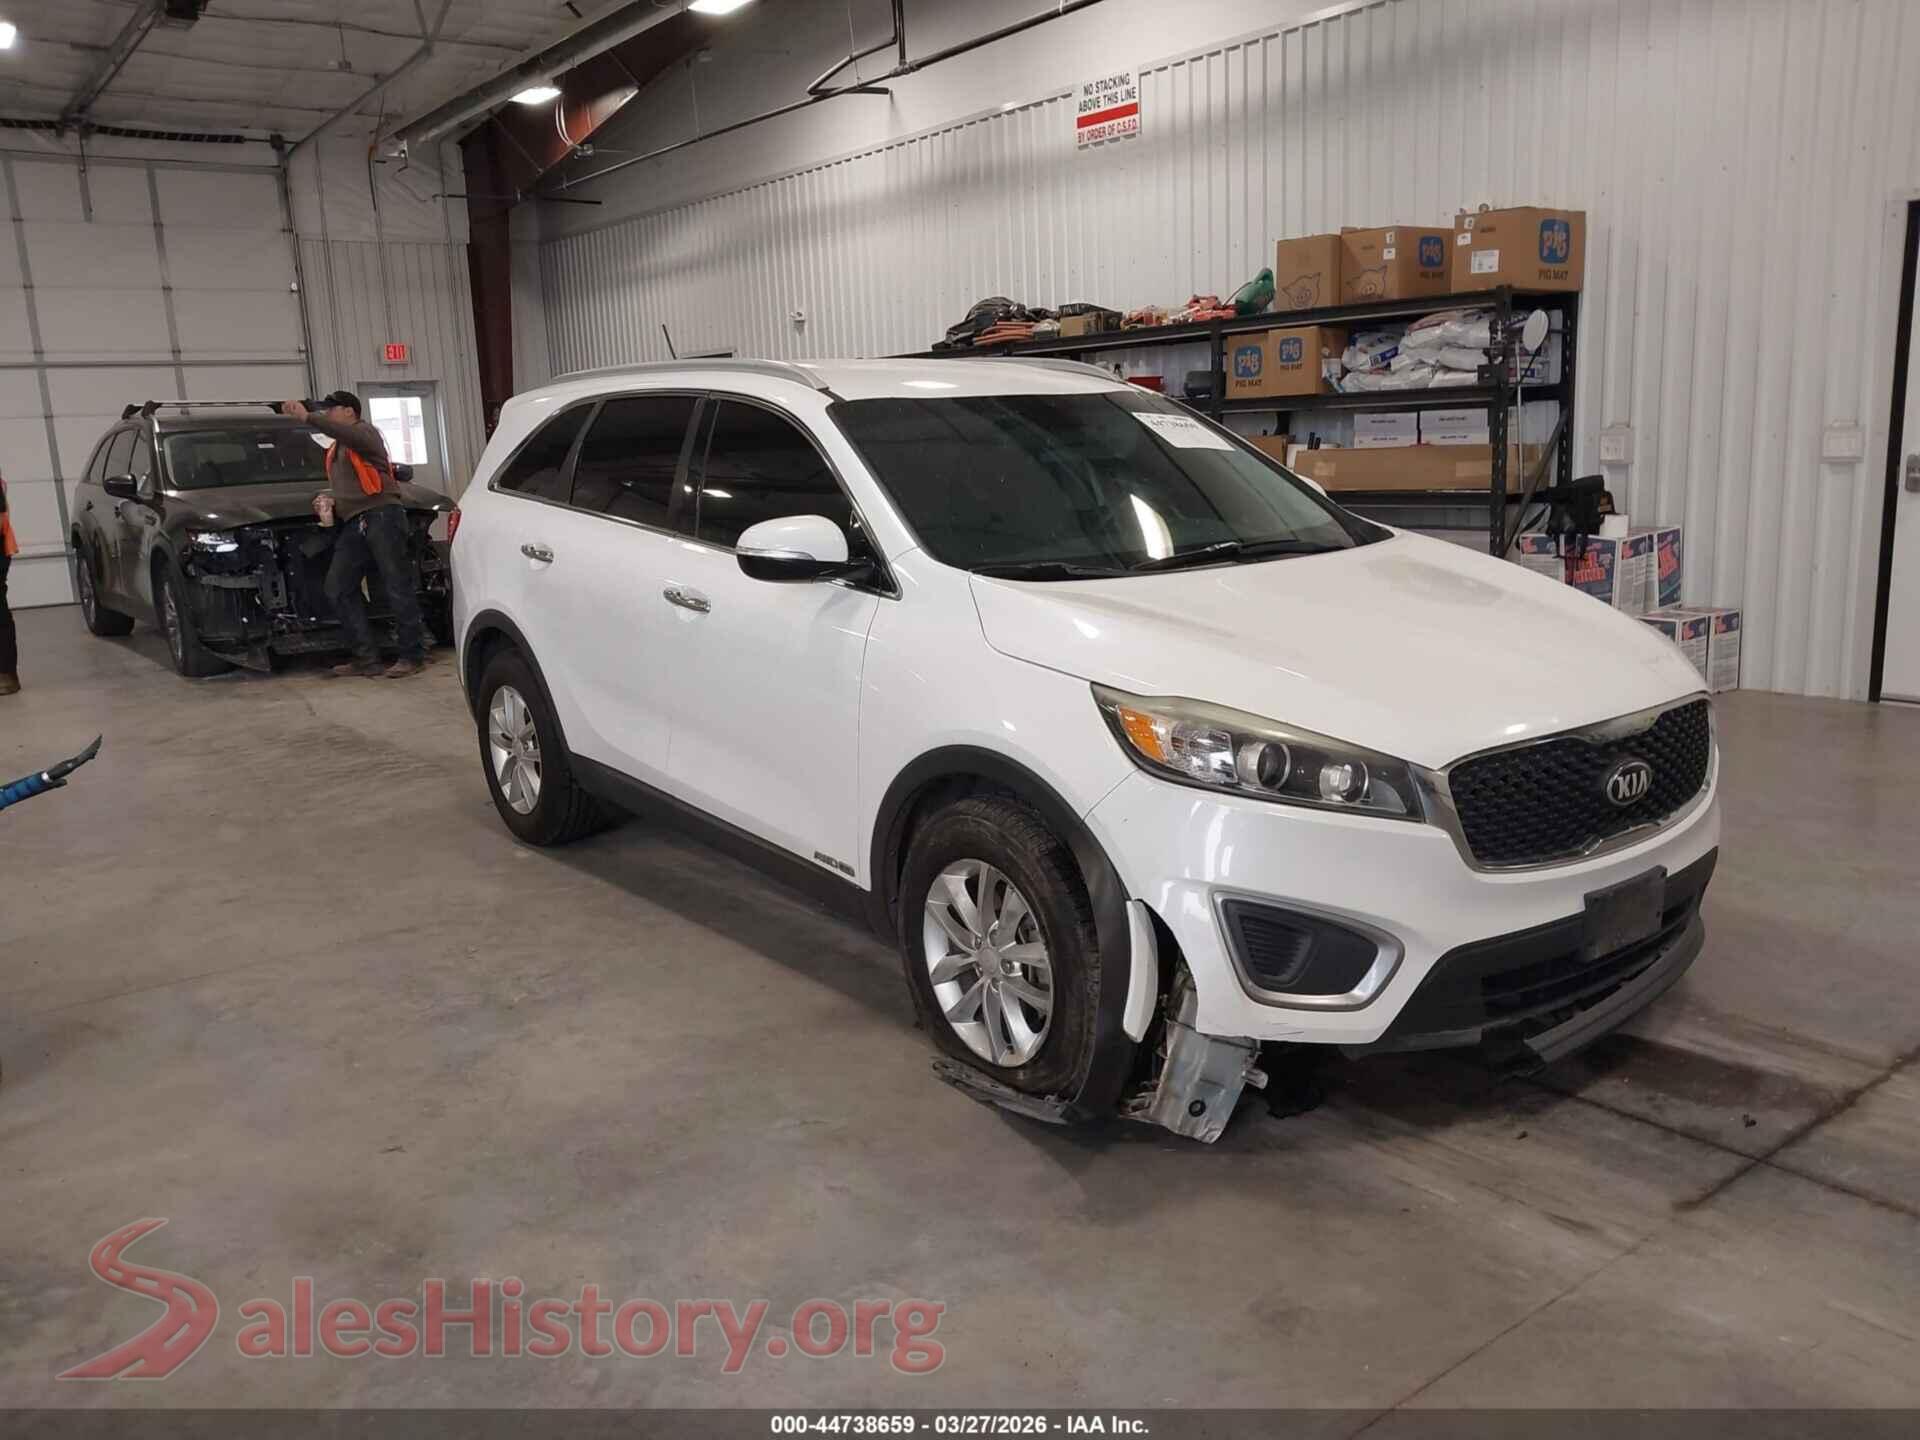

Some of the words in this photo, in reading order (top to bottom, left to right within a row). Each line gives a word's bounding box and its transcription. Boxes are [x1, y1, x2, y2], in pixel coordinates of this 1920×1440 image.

[1083, 83, 1094, 97] NO
[1095, 72, 1130, 94] STACKING
[1079, 96, 1102, 113] ABOVE
[1103, 91, 1119, 105] THIS
[1120, 86, 1137, 102] LINE
[1077, 131, 1086, 144] BY
[1087, 126, 1106, 141] ORDER
[1107, 122, 1116, 136] OF
[1617, 770, 1648, 800] KIA
